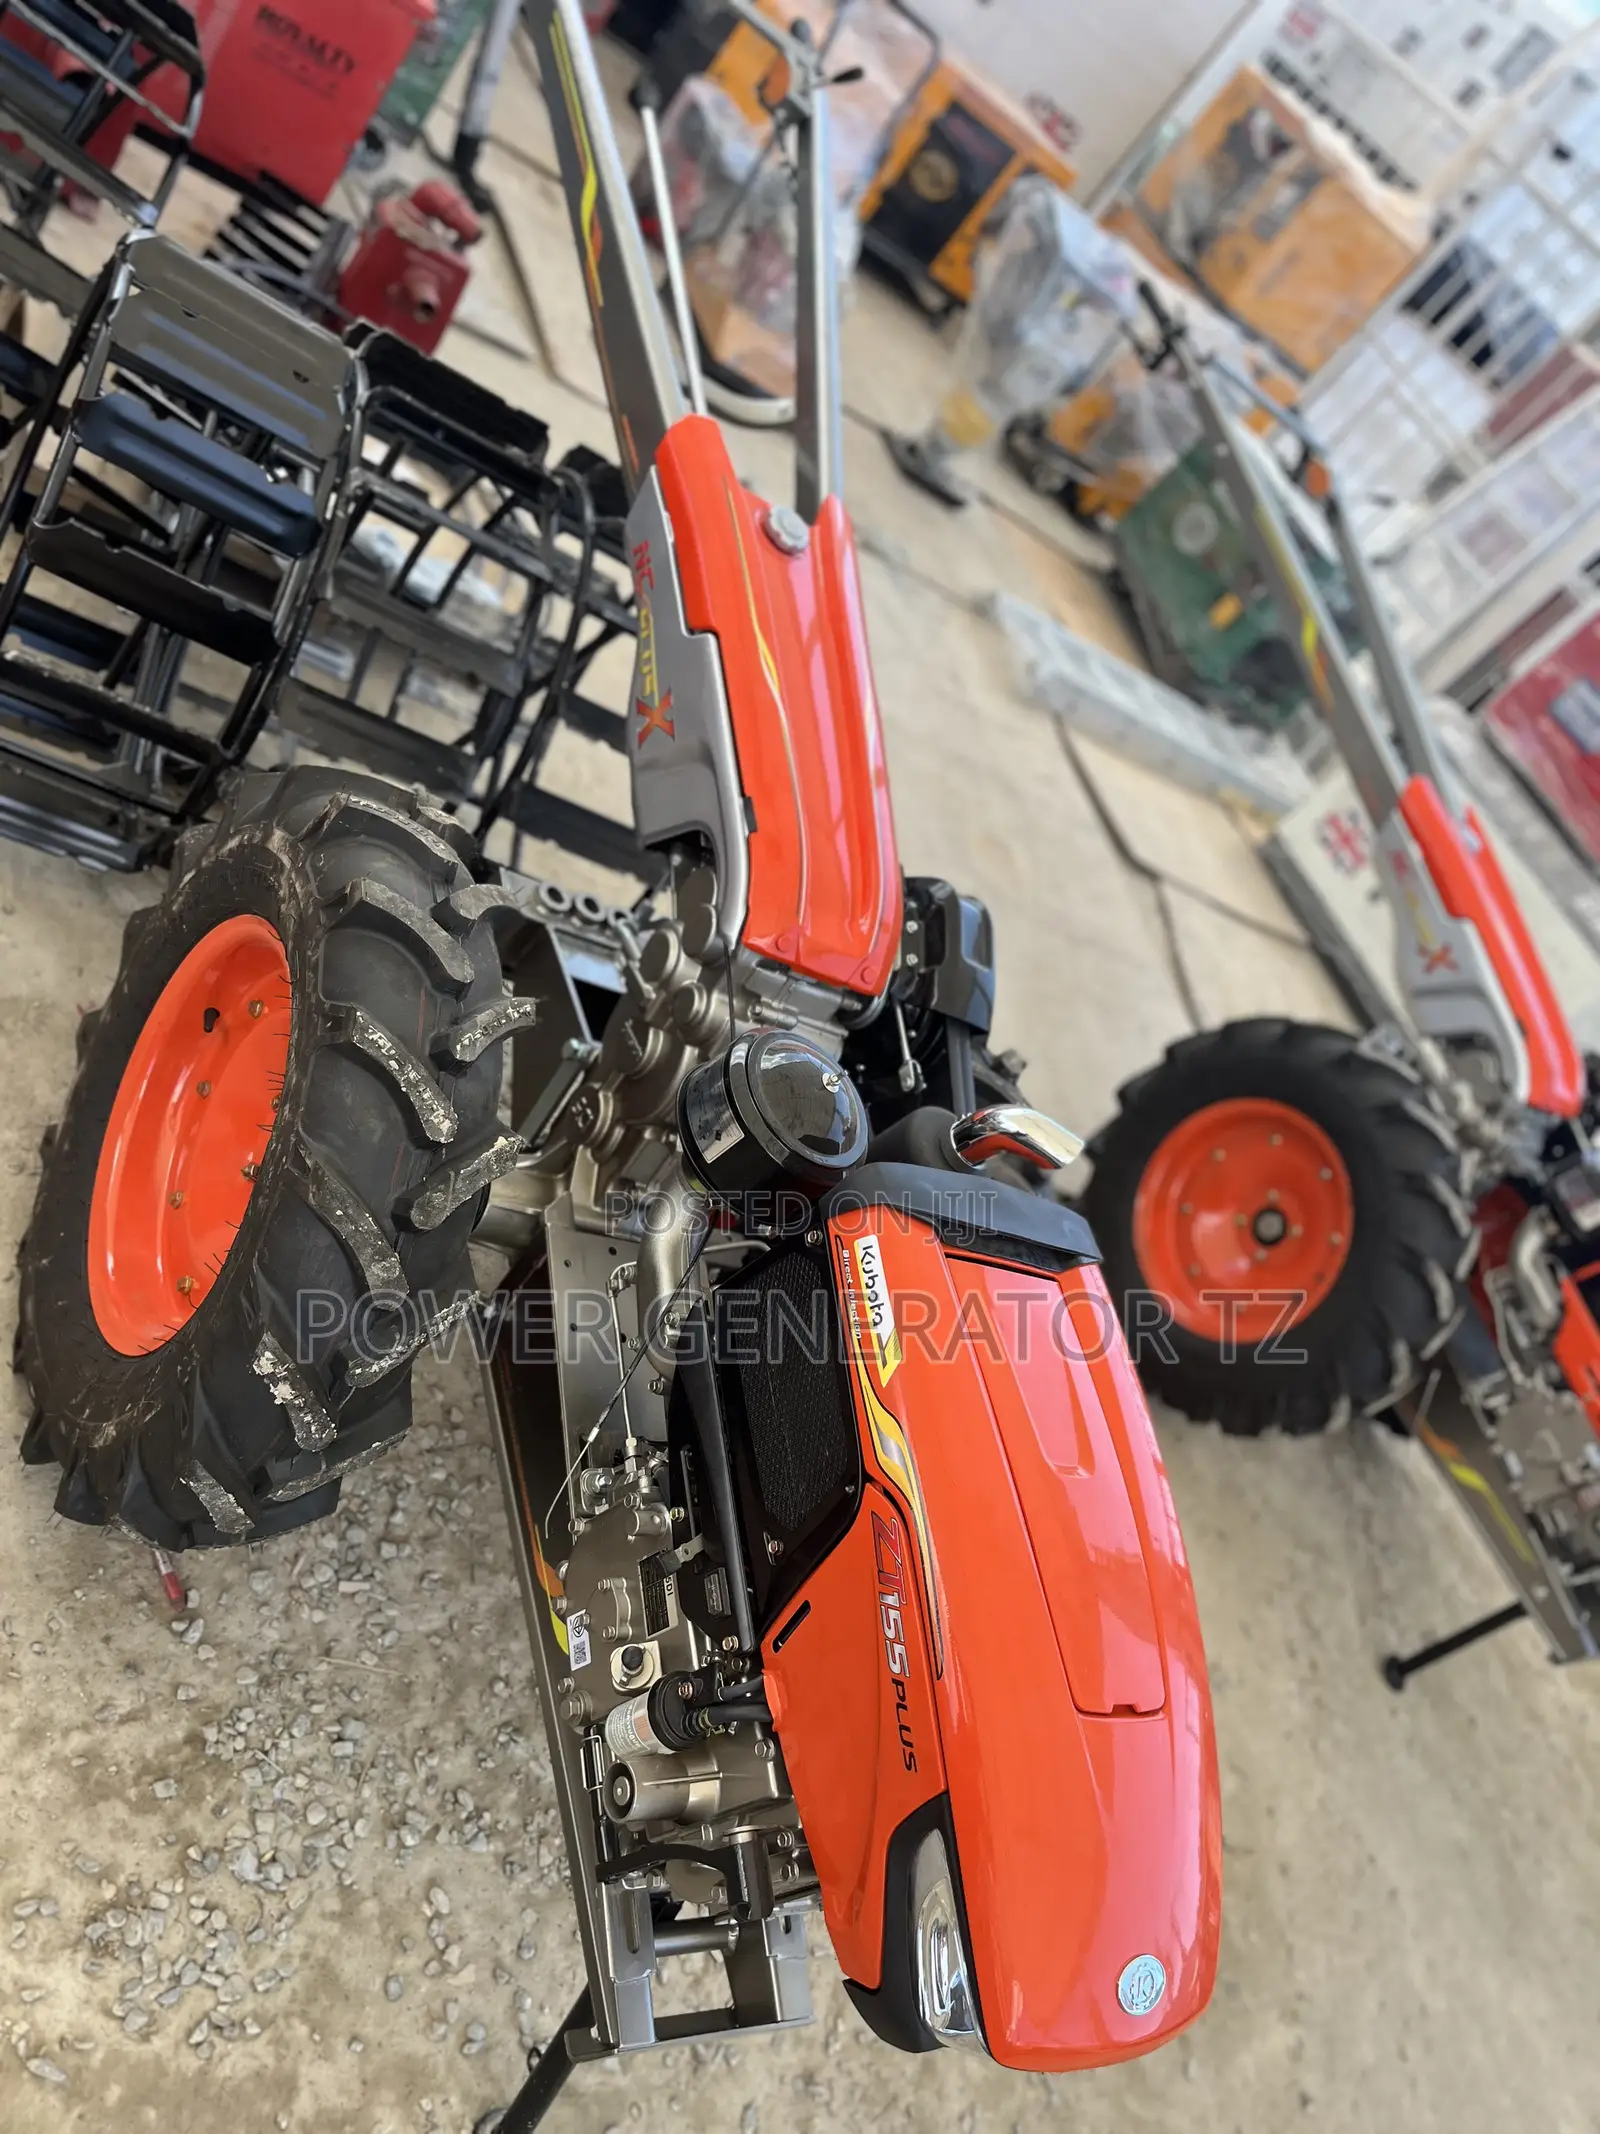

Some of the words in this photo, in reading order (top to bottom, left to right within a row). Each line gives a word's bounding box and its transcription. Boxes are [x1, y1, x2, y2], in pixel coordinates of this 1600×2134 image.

[860, 1245, 884, 1327] Kubota
[871, 1510, 910, 1678] ZT155
[891, 1677, 918, 1773] PLUS
